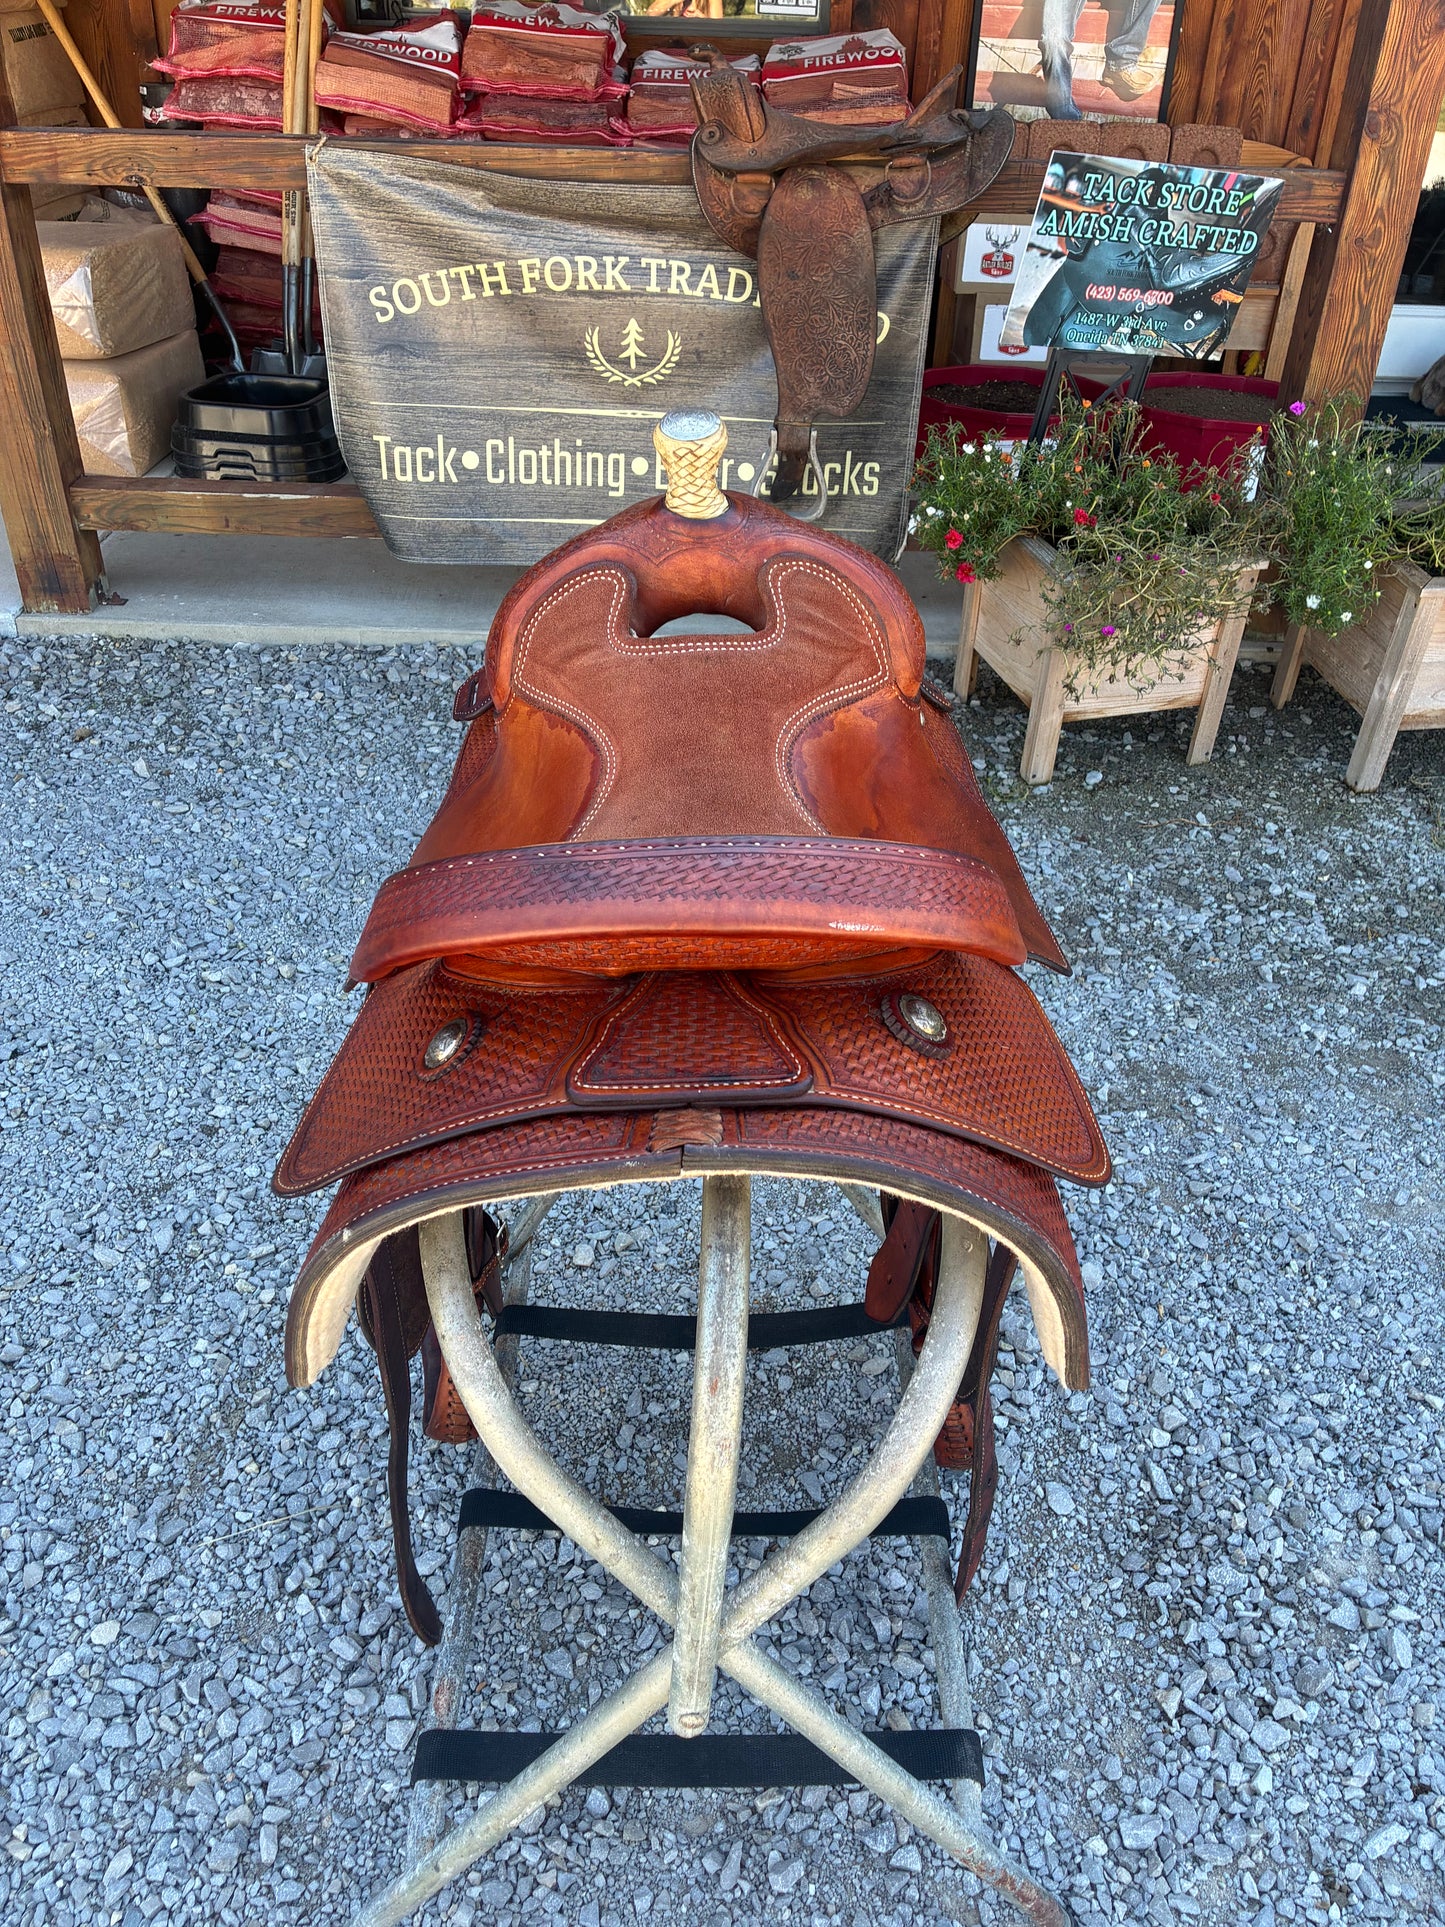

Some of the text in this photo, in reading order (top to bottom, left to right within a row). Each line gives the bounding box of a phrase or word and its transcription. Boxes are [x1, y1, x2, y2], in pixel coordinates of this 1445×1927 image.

[215, 5, 287, 20] FIREW
[343, 37, 452, 64] FIREWOOD
[642, 69, 748, 79] FIREW
[1083, 172, 1244, 217] TACK STORE
[1037, 208, 1258, 255] AMISH CRAFTED
[368, 255, 762, 323] SOUTH FORK TRAD
[1085, 282, 1116, 301] (423)
[1074, 312, 1103, 326] 1487
[1106, 313, 1120, 327] W
[1143, 318, 1168, 331] Ave
[1066, 329, 1164, 349] Oneida TN 37841
[372, 434, 459, 483] Tack
[485, 436, 625, 497] Clothing
[761, 450, 880, 496] Sacks
